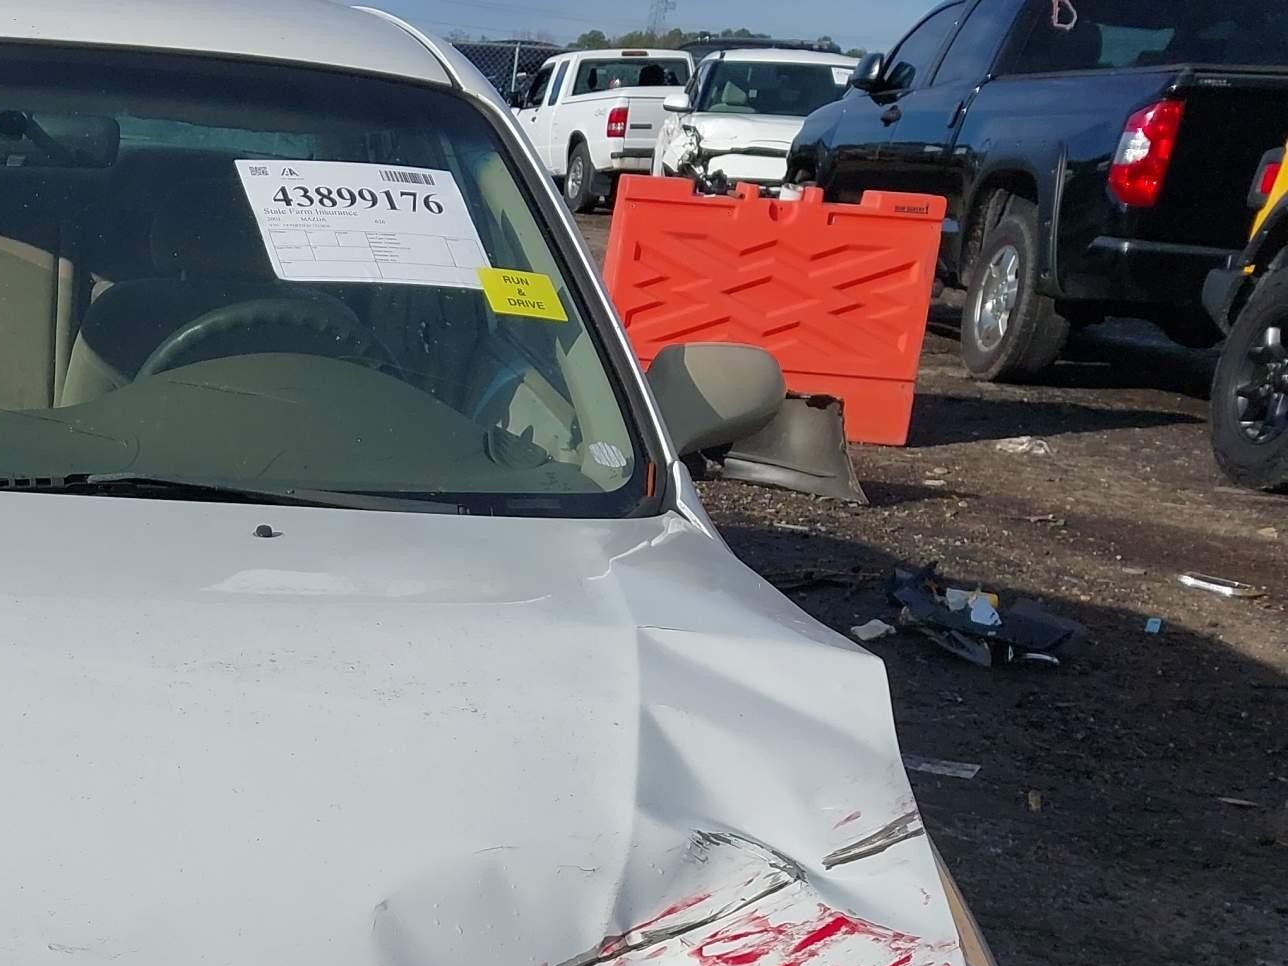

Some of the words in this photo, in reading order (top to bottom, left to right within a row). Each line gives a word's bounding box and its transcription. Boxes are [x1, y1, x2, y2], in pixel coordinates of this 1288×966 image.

[273, 185, 444, 215] 43899176
[263, 207, 287, 216] State
[289, 207, 313, 216] Farm
[315, 207, 359, 217] Insurance
[502, 275, 530, 287] RUN
[516, 287, 526, 297] &
[507, 298, 546, 311] DRIVE
